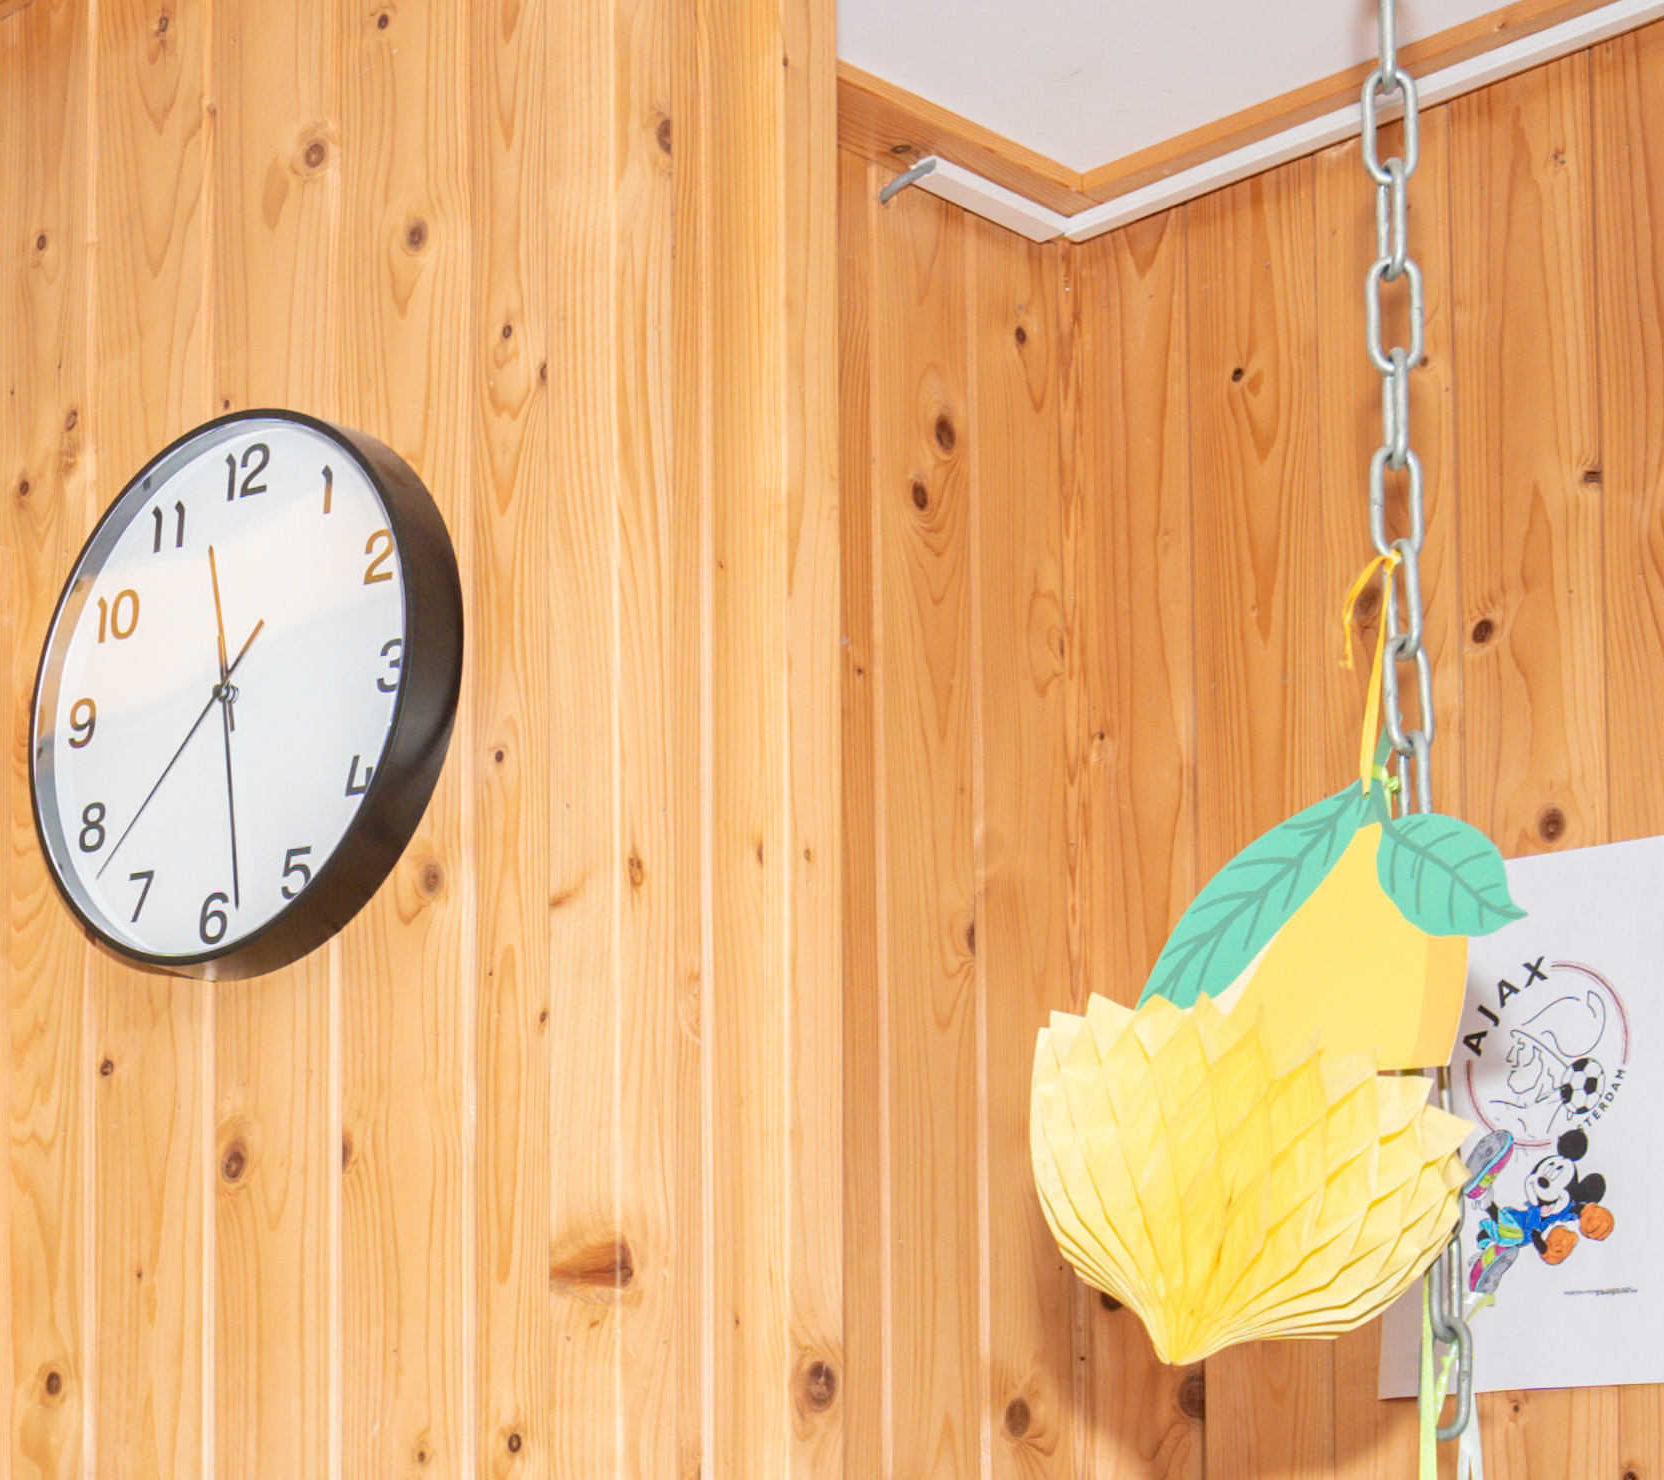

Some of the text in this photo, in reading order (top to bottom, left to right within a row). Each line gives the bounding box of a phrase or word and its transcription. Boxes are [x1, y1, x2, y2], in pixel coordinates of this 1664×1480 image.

[225, 443, 270, 501] 12
[321, 465, 333, 514] 1
[152, 500, 186, 553] 11
[363, 528, 395, 585] 2
[97, 588, 140, 643] 10
[376, 638, 402, 693] 3
[68, 697, 97, 748] 9
[345, 754, 373, 797] 4
[78, 802, 106, 853] 8
[129, 870, 155, 923] 7
[280, 846, 313, 901] 5
[198, 892, 229, 945] 6
[1462, 955, 1548, 1057] AJAX
